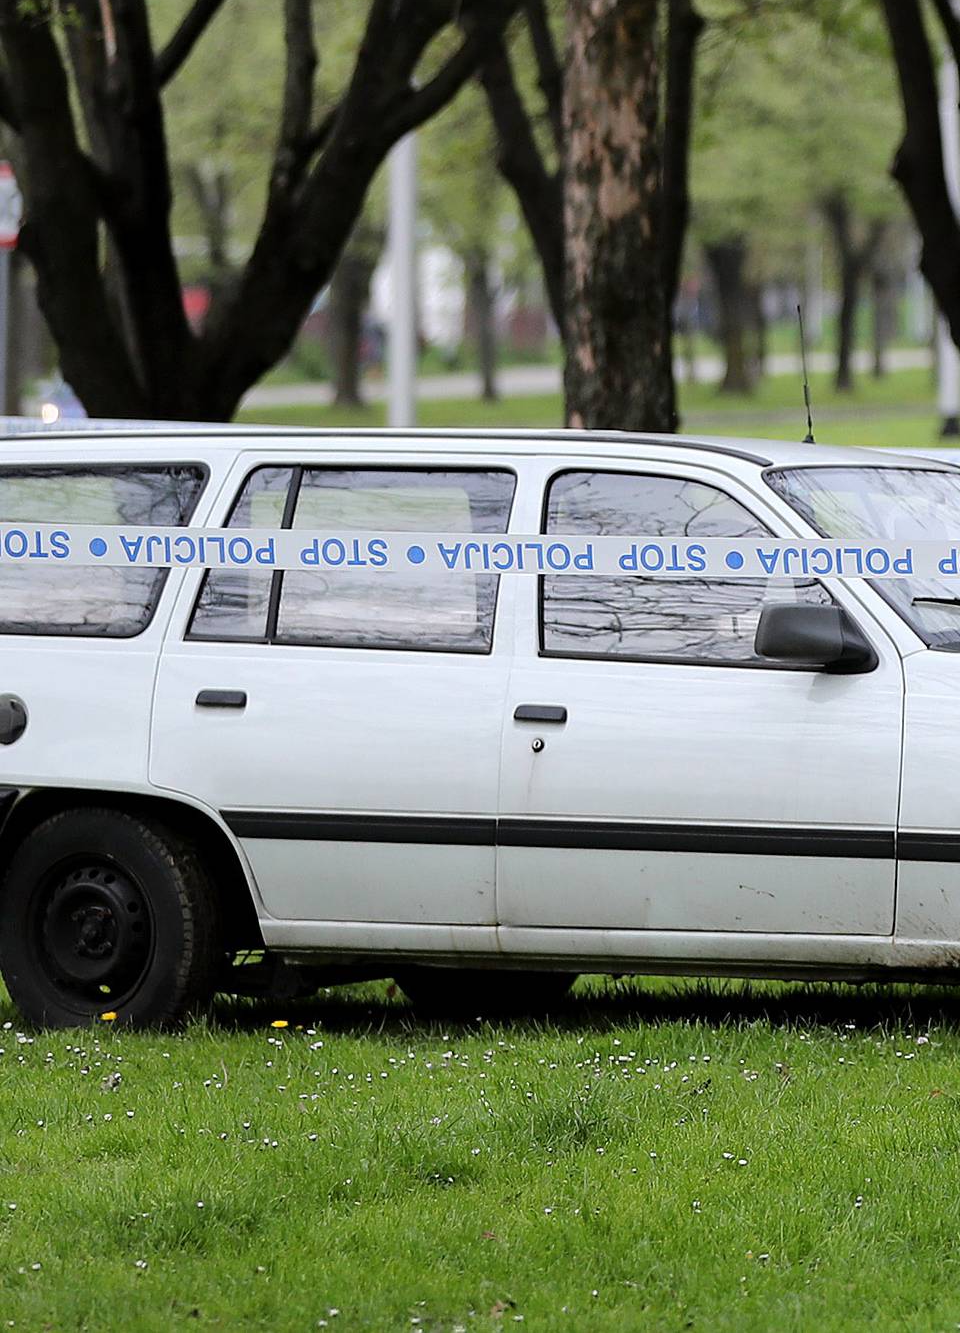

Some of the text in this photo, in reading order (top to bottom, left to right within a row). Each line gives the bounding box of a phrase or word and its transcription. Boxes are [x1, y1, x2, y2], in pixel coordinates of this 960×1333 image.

[0, 529, 70, 559] STO
[120, 535, 275, 565] POLICIJA
[300, 537, 388, 566] STOP
[438, 542, 593, 571] POLICIJA
[619, 543, 706, 572] STOP
[756, 547, 913, 574] POLICIJA
